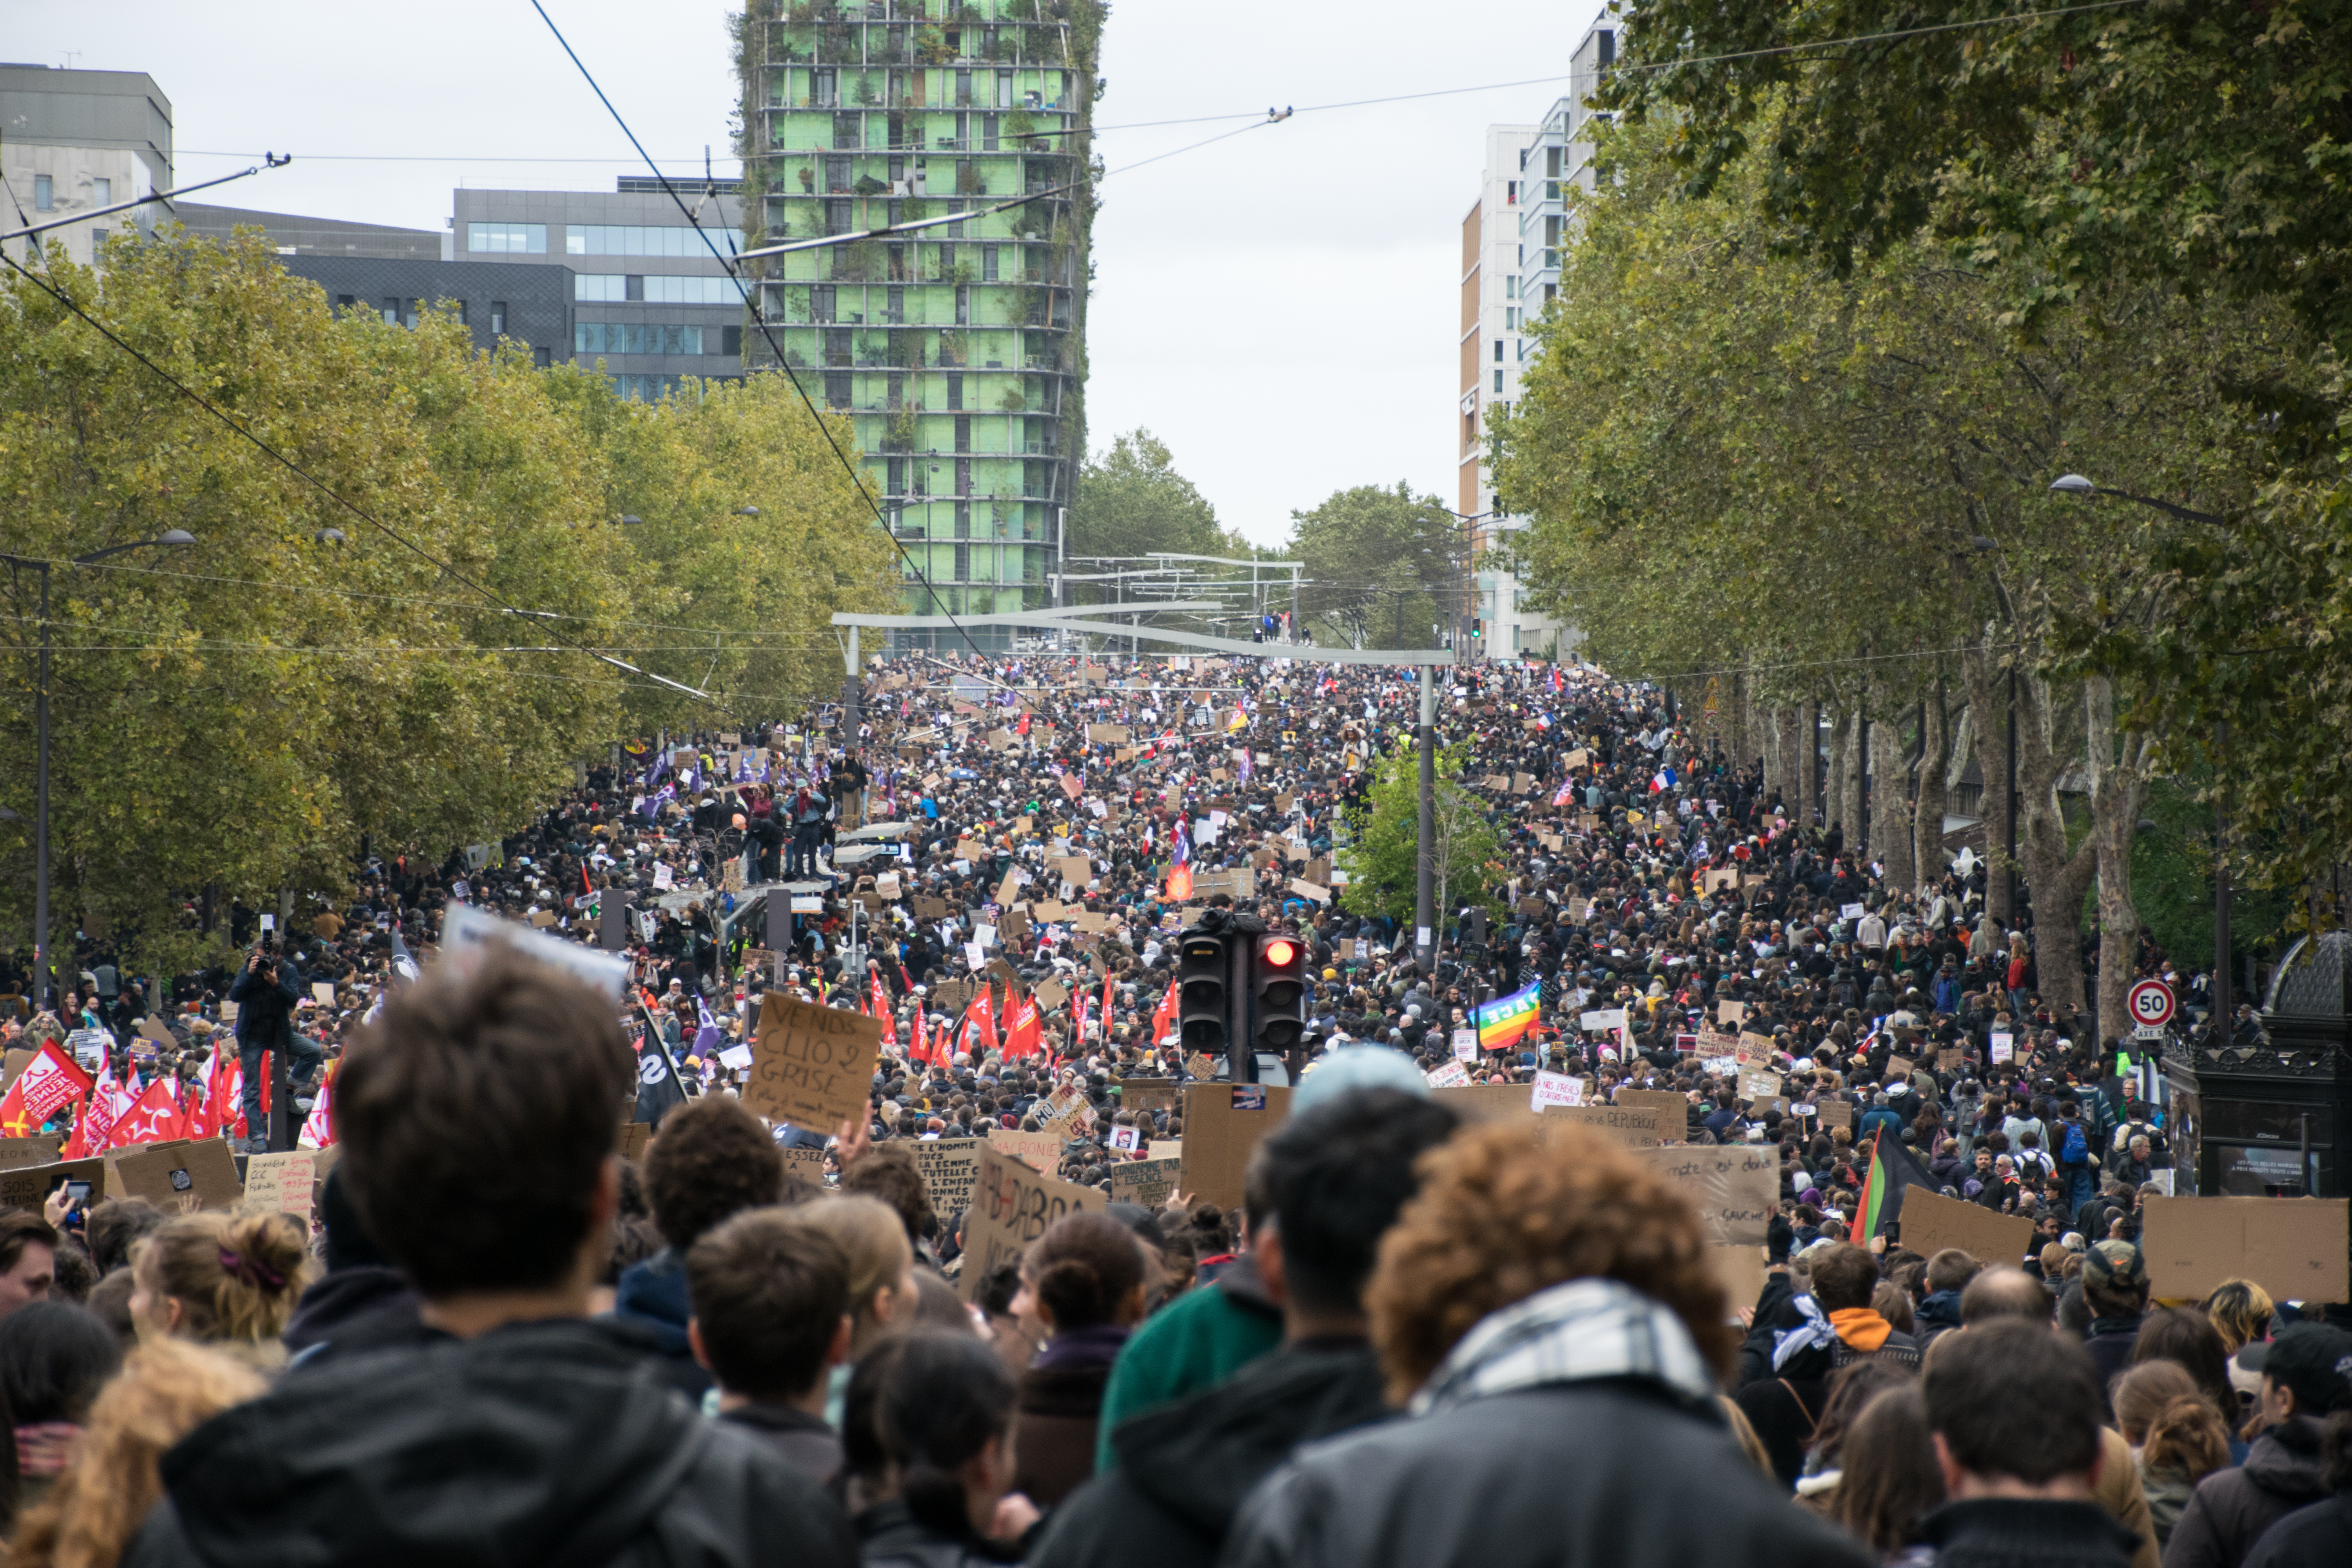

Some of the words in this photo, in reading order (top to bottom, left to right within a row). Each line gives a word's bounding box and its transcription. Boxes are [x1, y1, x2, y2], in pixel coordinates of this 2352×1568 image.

[2140, 995, 2164, 1013] 50
[771, 998, 857, 1035] VENDS
[1719, 1036, 1739, 1045] DICTATU
[2138, 1030, 2154, 1038] AXE
[762, 1028, 831, 1065] CLIO
[839, 1045, 859, 1074] 2
[760, 1058, 842, 1097] GRISE
[1429, 1074, 1440, 1085] LA
[1439, 1063, 1464, 1079] JEUNESSE
[1542, 1080, 1554, 1091] NOS
[87, 1103, 112, 1132] UNE
[1034, 1102, 1056, 1128] MOI
[910, 1144, 924, 1152] DE
[928, 1141, 976, 1152] L'HOMME
[993, 1141, 1059, 1157] MACRONIE
[786, 1150, 822, 1162] ESSEZ
[918, 1152, 944, 1160] OUÉS
[935, 1159, 973, 1169] FEMME
[1113, 1160, 1161, 1176] CONDAMNE
[1163, 1158, 1180, 1171] PAR
[921, 1168, 969, 1178] TUTELLE
[1125, 1172, 1163, 1186] ESSENCE
[1, 1178, 35, 1194] SOIS
[932, 1178, 976, 1187] L'ENFAN
[1137, 1180, 1174, 1194] MINORITY
